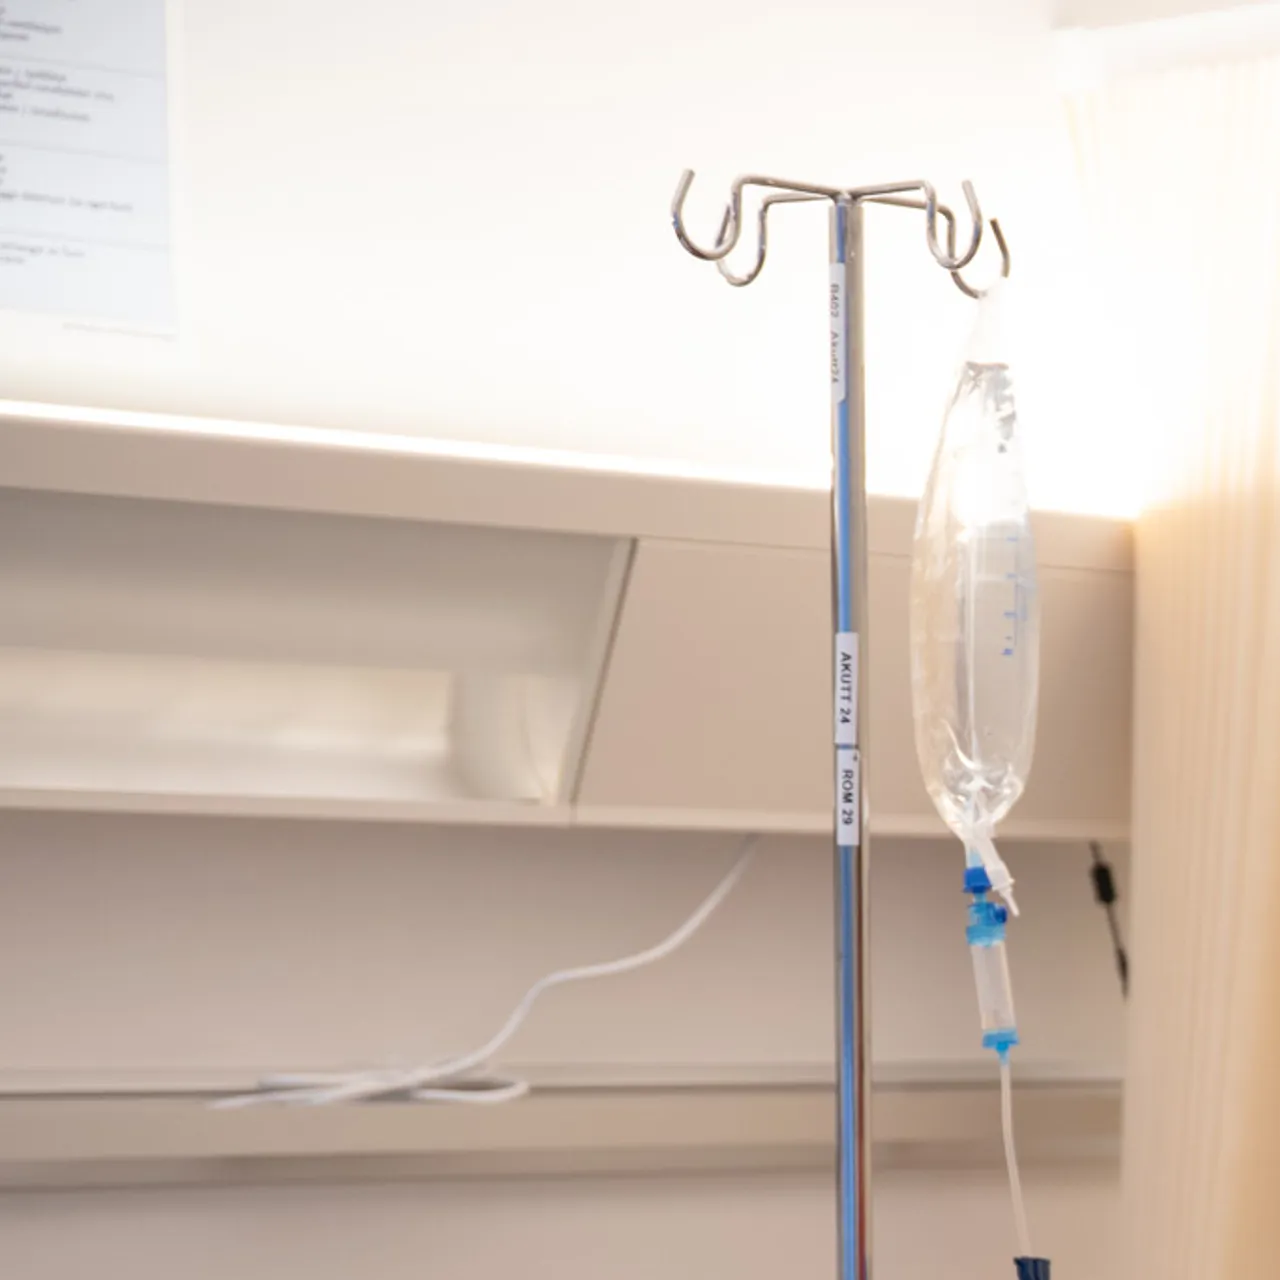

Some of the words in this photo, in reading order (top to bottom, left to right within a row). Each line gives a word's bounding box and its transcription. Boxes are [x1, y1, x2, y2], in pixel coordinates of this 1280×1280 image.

[840, 652, 853, 702] AKUTT
[840, 708, 851, 724] 24
[842, 769, 854, 803] ROM
[842, 809, 853, 825] 29
